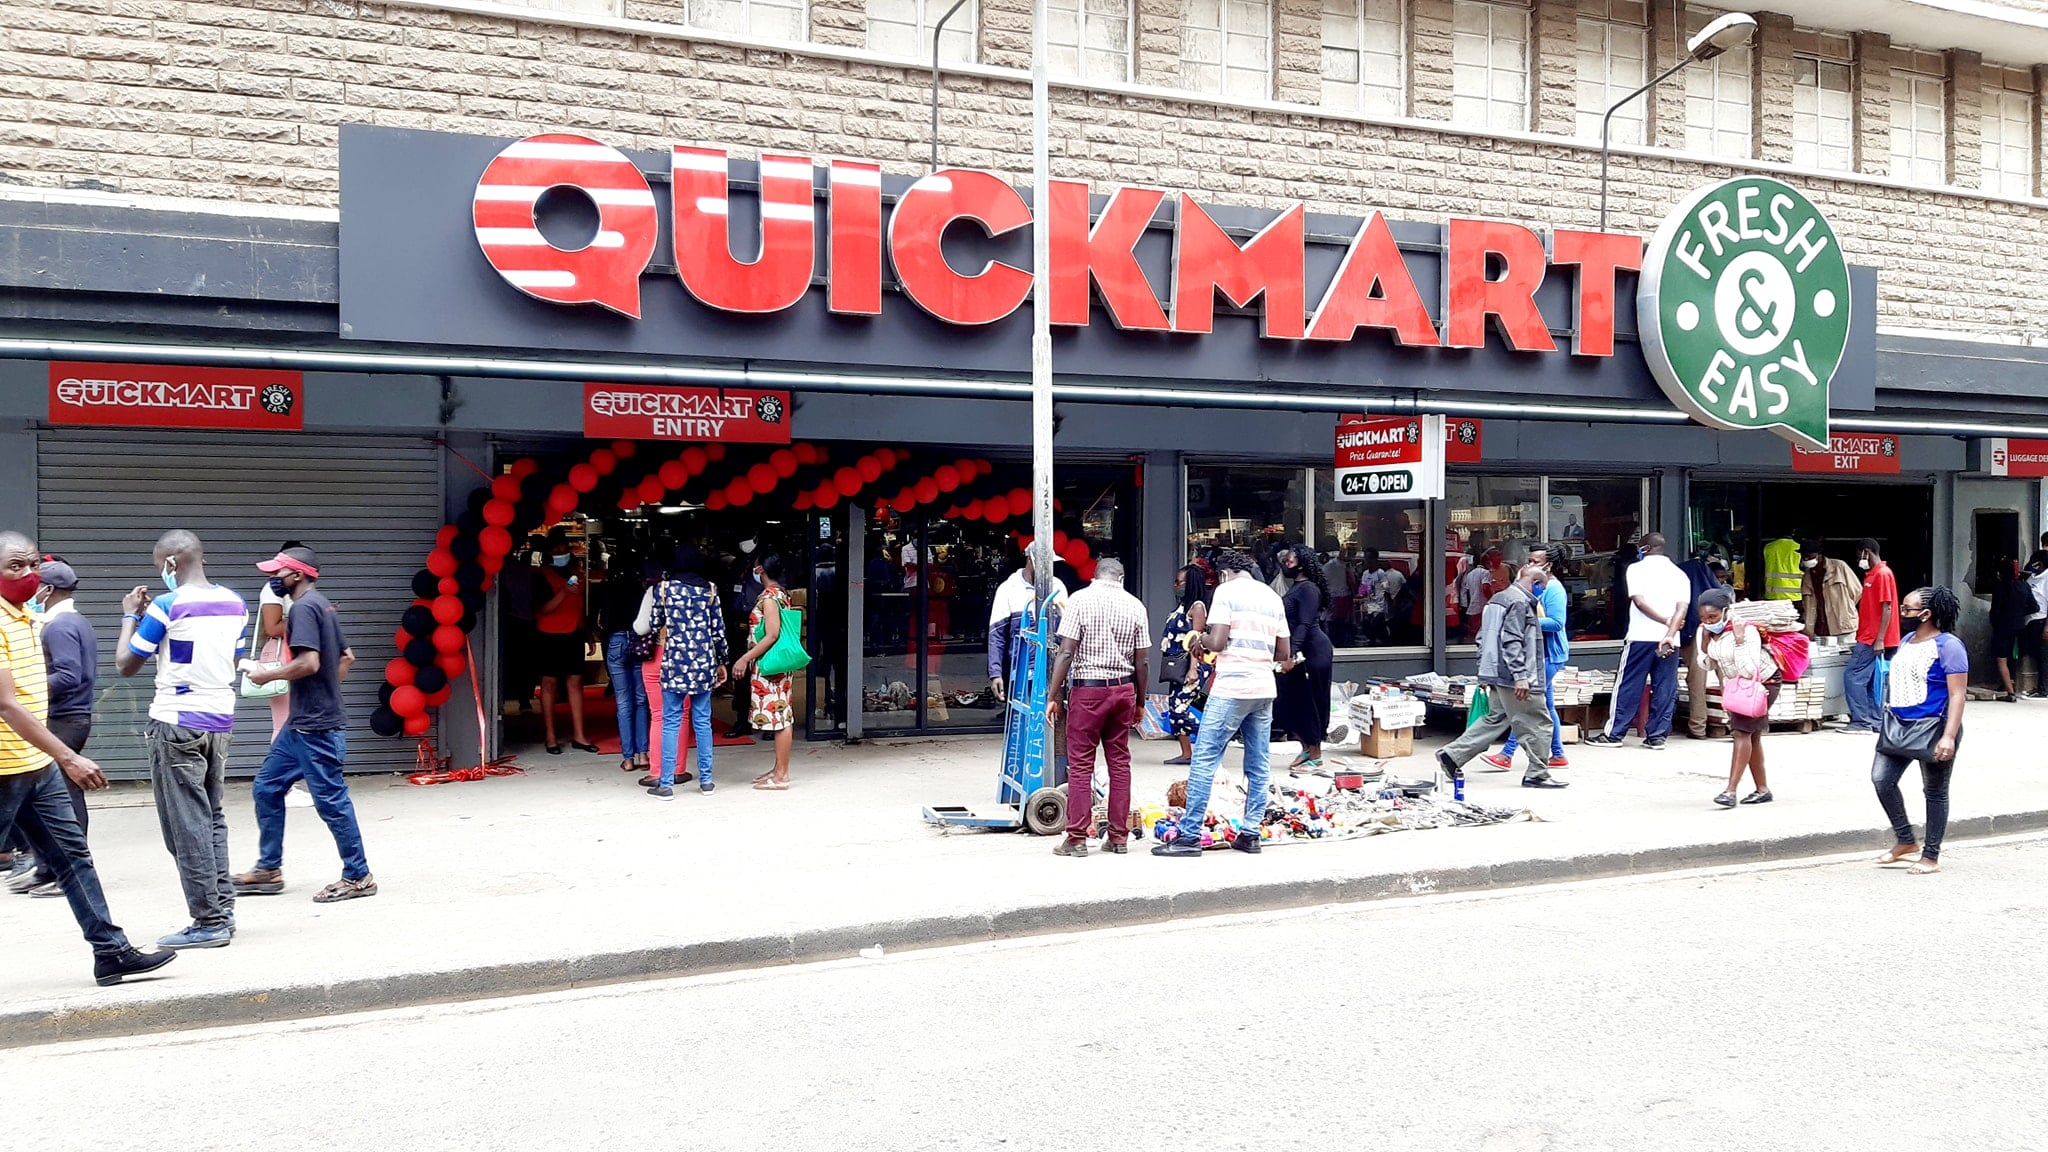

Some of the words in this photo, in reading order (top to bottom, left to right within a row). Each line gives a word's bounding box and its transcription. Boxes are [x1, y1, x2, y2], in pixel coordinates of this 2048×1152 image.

[1675, 186, 1828, 280] FRESH
[473, 133, 1643, 357] QUICKMART
[1735, 268, 1779, 339] &
[1699, 339, 1818, 419] EASY
[57, 378, 255, 410] QUICKMART
[262, 384, 290, 396] FRESH
[266, 402, 289, 413] EASY
[590, 391, 752, 419] QUICKMART
[758, 395, 780, 406] FRESH
[652, 417, 725, 437] ENTRY
[1337, 426, 1405, 449] QUICKMART
[1795, 437, 1880, 456] KMART
[1349, 450, 1365, 461] Price
[1366, 447, 1402, 460] Guarantee!
[1833, 455, 1860, 470] EXIT
[2009, 453, 2038, 463] LUGGAGE
[2038, 454, 2048, 463] DE
[1346, 476, 1368, 492] 24-7
[1380, 474, 1408, 491] OPEN
